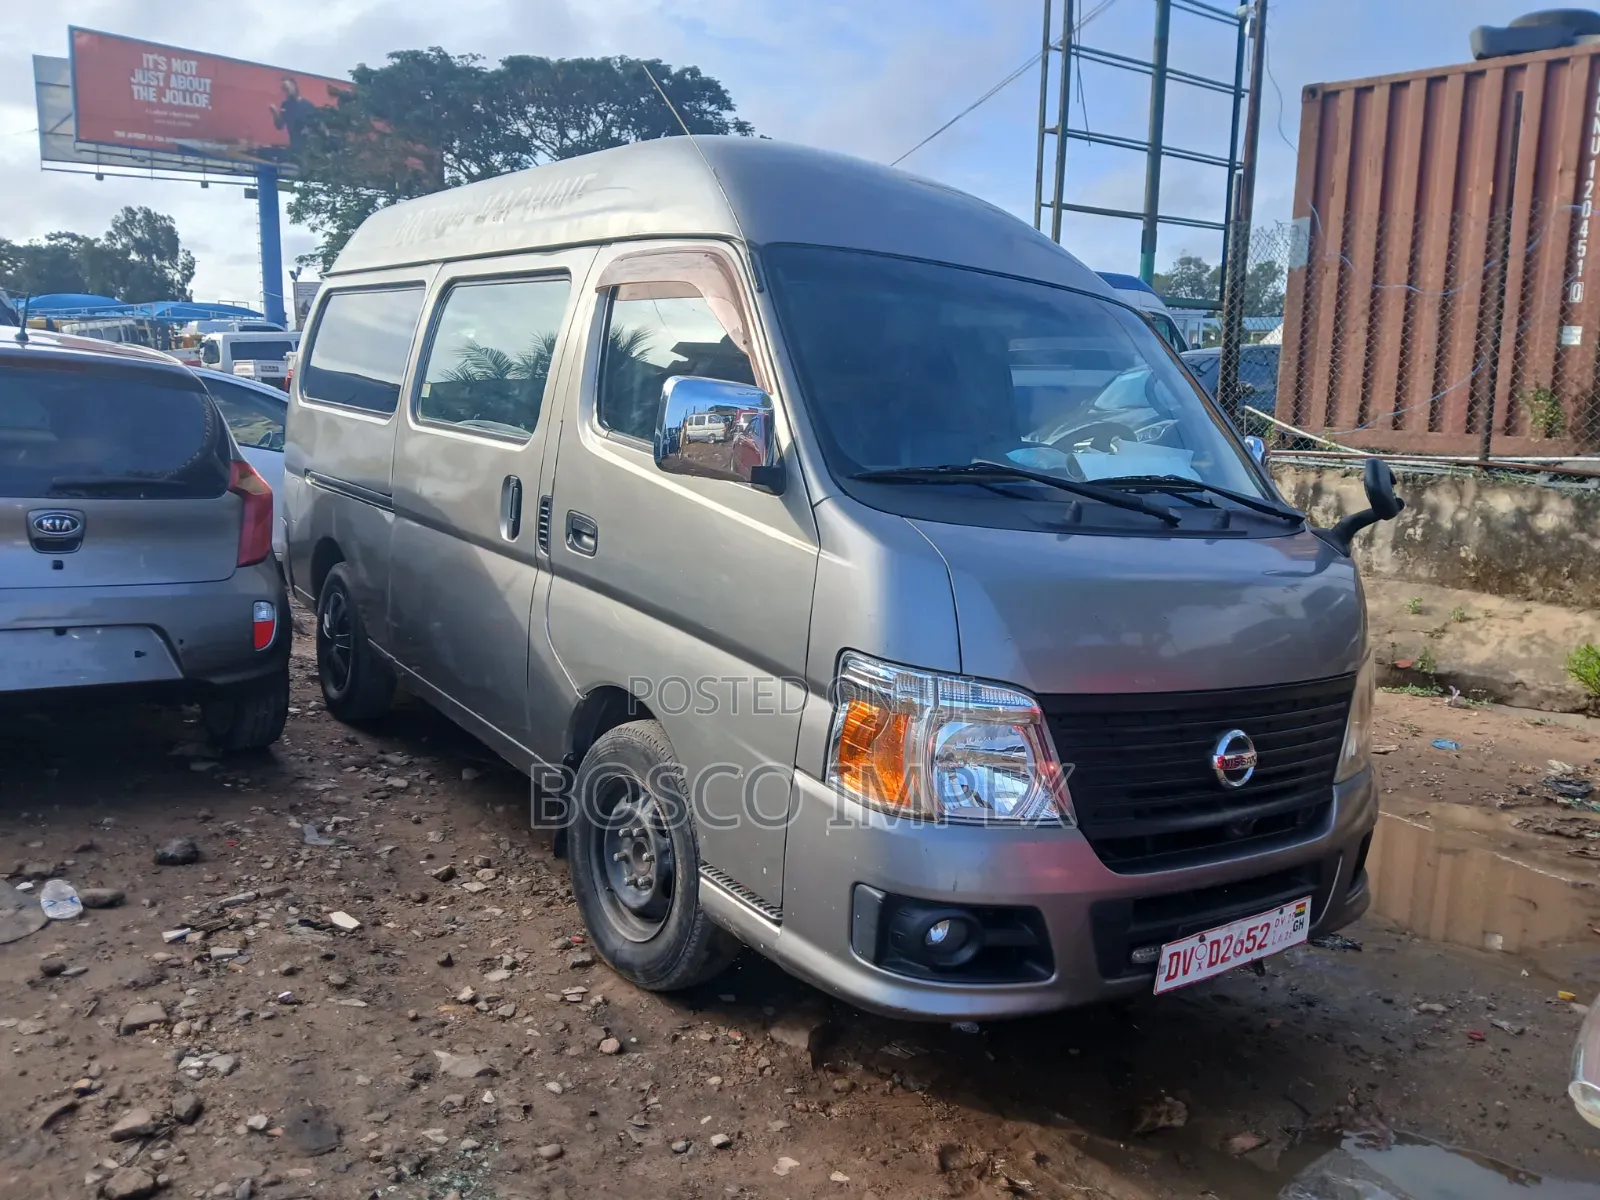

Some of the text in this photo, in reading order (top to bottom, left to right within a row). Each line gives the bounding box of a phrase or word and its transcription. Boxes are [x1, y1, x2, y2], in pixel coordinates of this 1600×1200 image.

[142, 53, 198, 75] IT'S NOT
[130, 68, 212, 93] JUST ABOUT
[131, 84, 212, 110] THE JOLLOF.
[42, 519, 72, 530] KIA
[1222, 755, 1256, 767] NISSAN
[1292, 917, 1305, 933] GH
[1164, 922, 1271, 982] DV D2652
